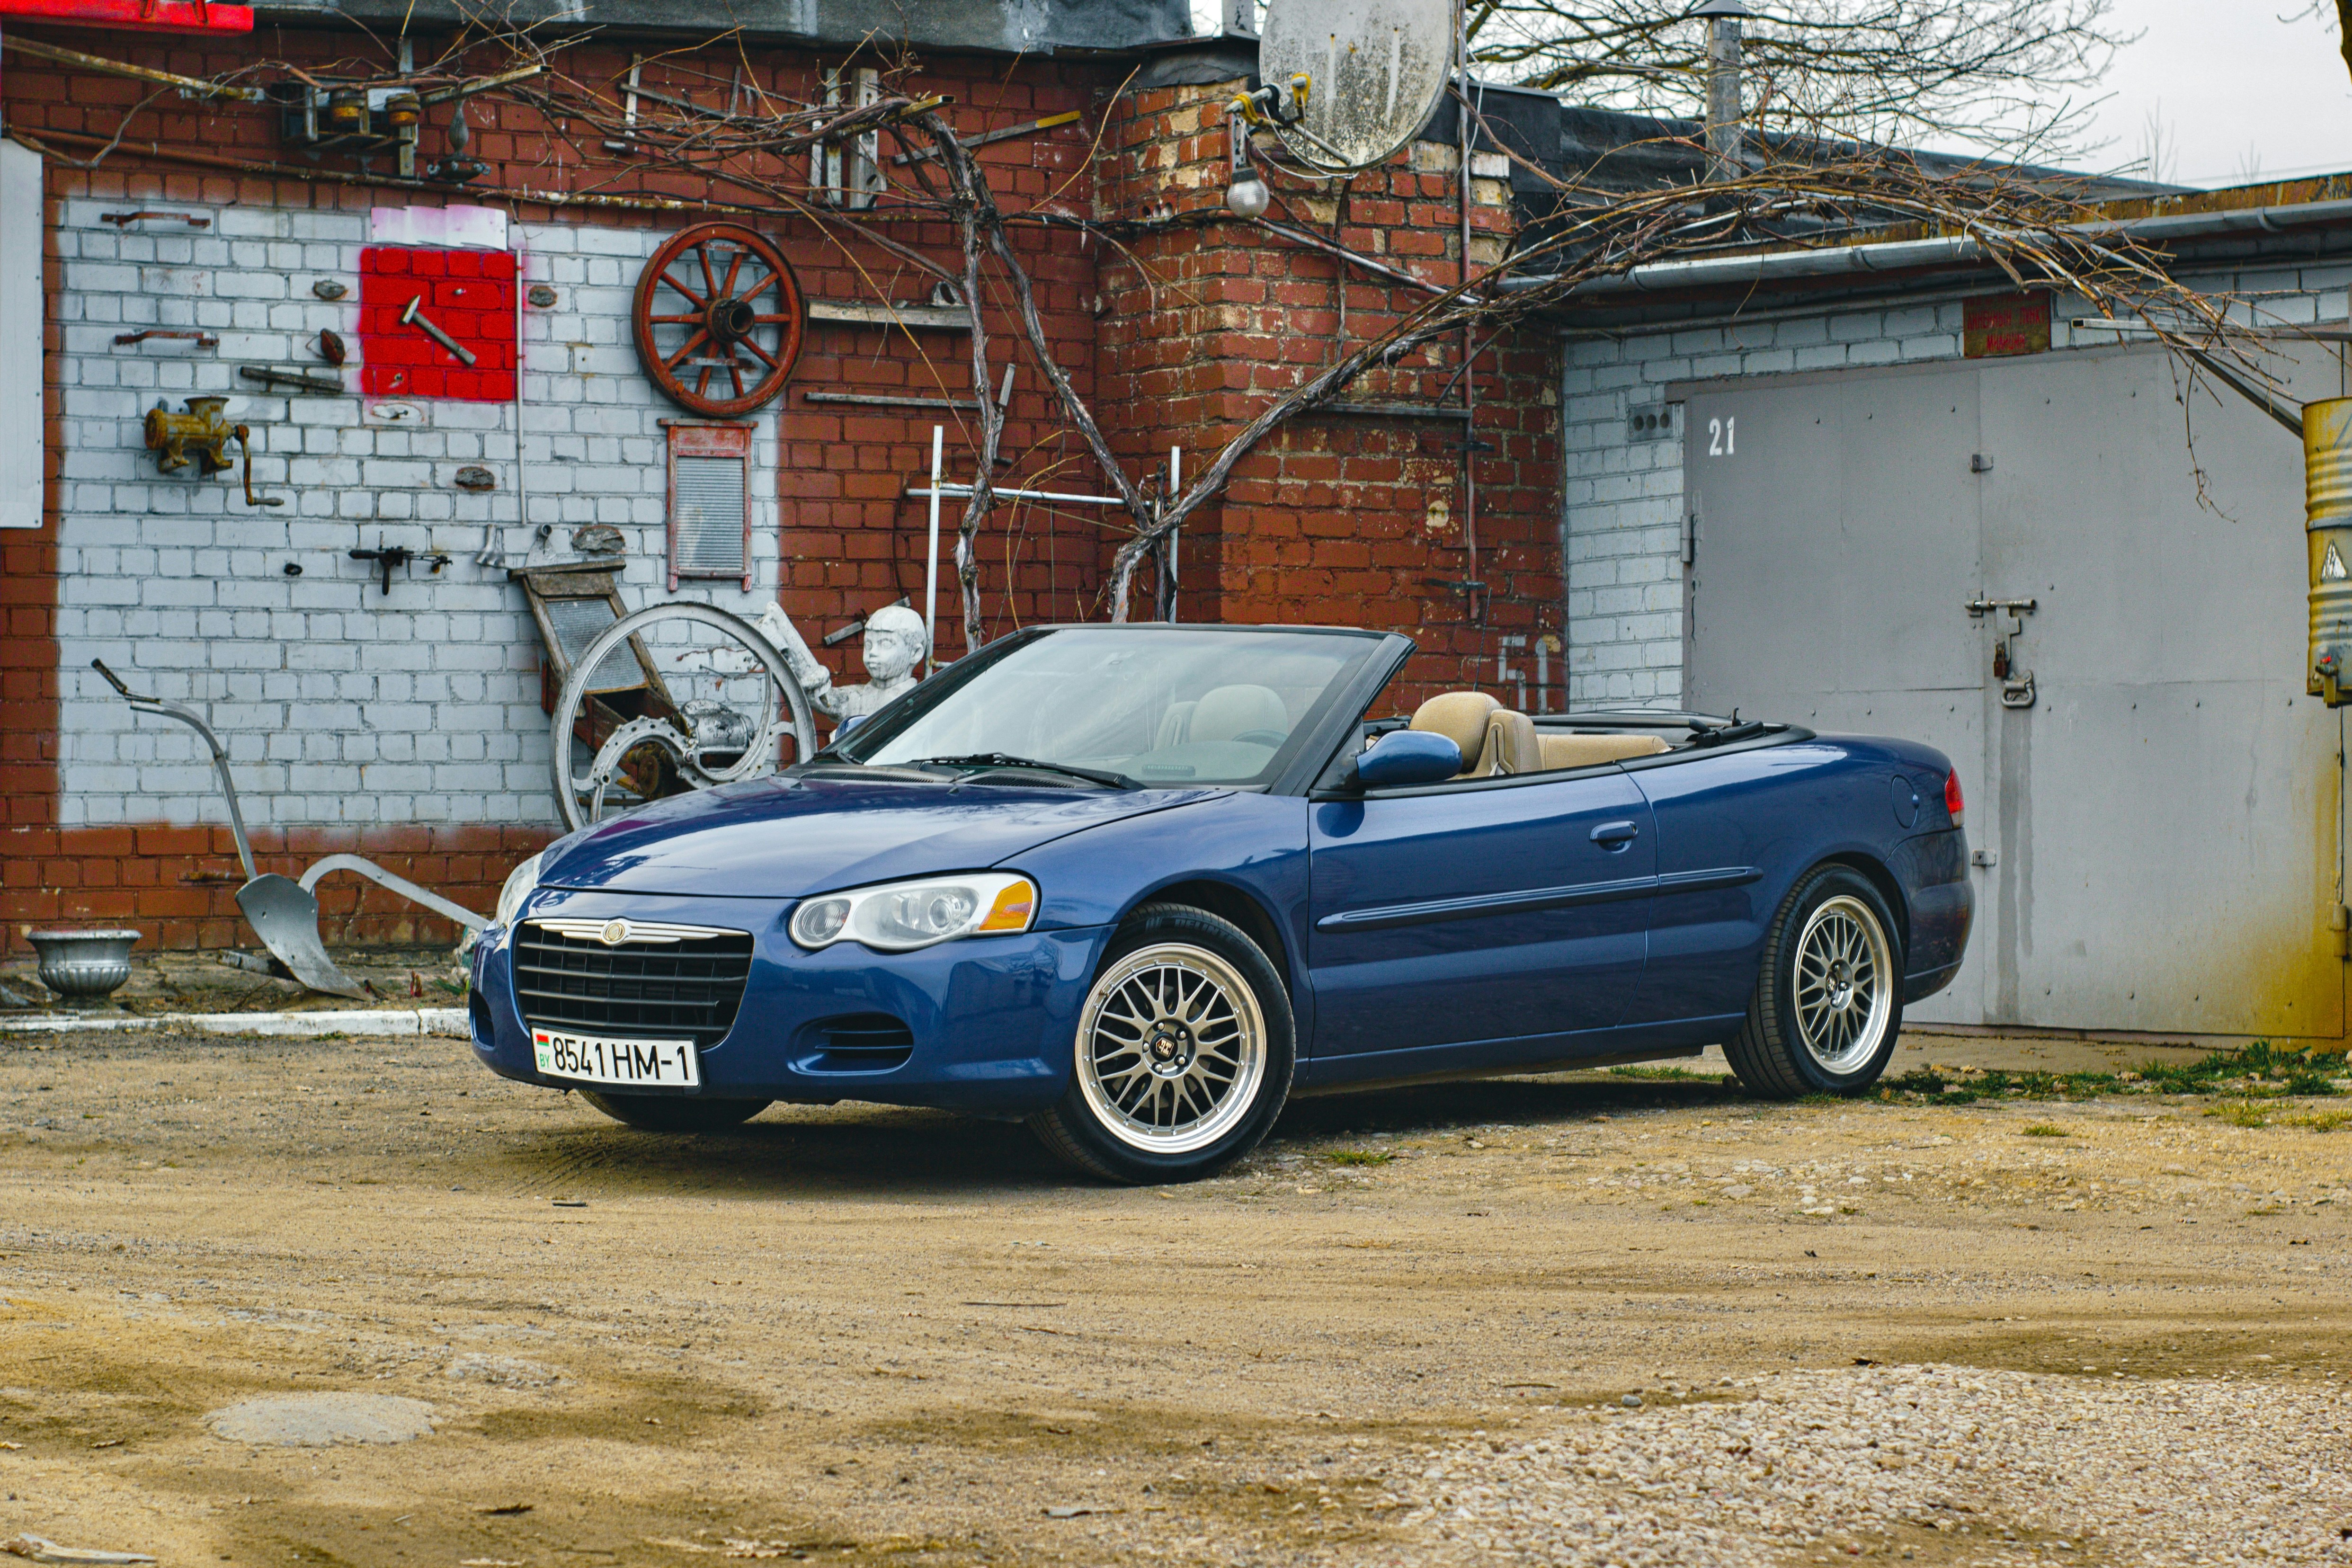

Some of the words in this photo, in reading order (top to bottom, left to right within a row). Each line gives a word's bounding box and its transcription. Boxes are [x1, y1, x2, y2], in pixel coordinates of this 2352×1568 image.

[1709, 417, 1734, 456] 21
[539, 1053, 550, 1068] BY
[553, 1037, 605, 1077] 8541
[611, 1043, 689, 1080] HM-1
